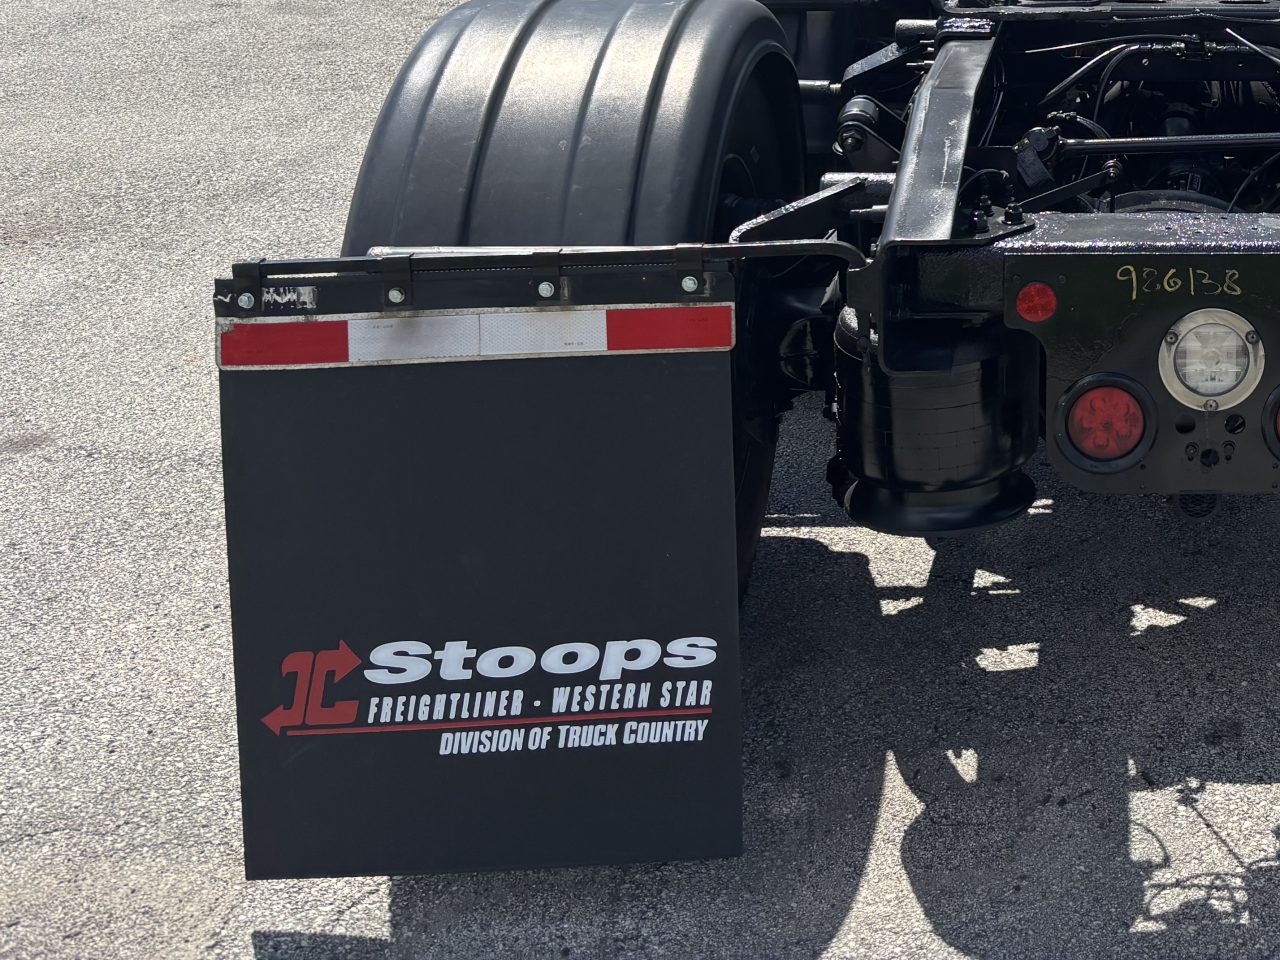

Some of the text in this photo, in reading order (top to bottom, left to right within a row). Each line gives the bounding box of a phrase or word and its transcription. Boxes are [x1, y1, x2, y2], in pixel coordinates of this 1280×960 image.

[363, 636, 718, 685] Stoops
[367, 679, 713, 724] FREIGHTLINER WESTERN STAR
[439, 719, 709, 756] DIVISION OF TRUCK COUNTRY
